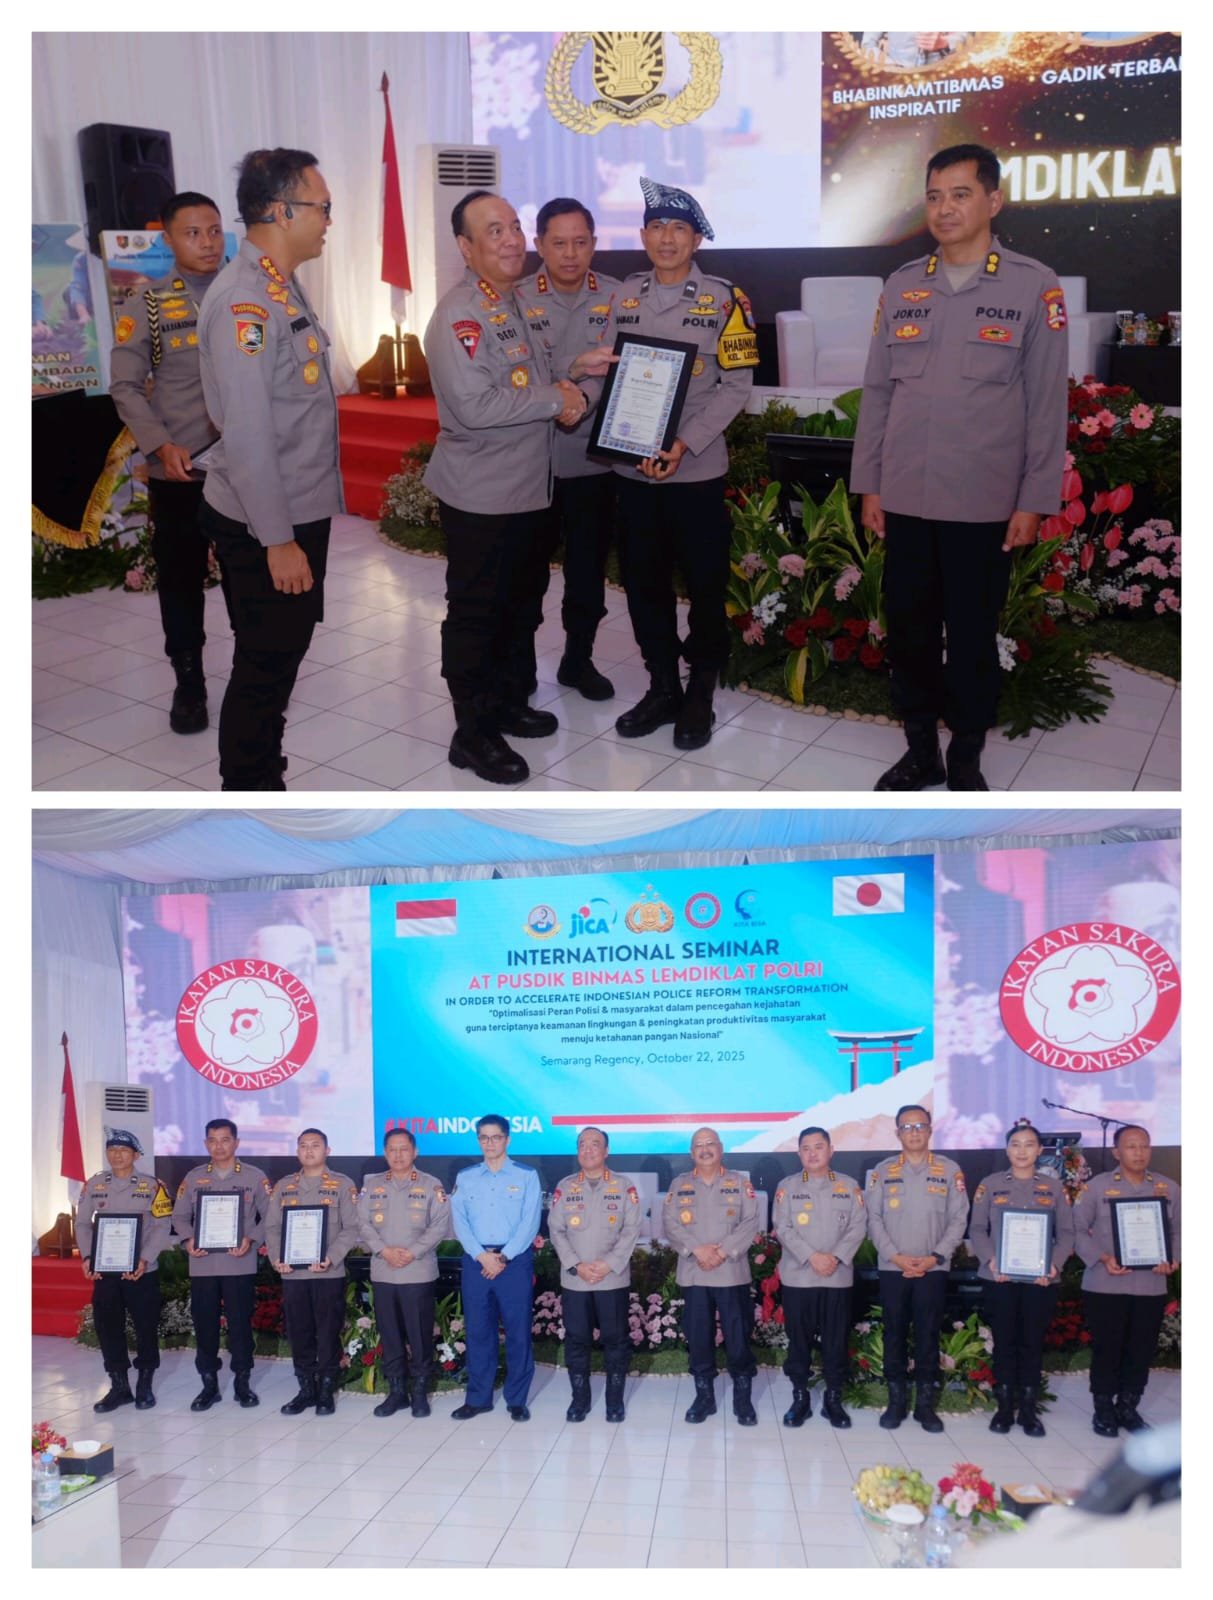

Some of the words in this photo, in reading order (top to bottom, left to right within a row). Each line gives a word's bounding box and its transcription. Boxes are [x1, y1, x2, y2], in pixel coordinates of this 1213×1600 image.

[1041, 64, 1106, 85] GADIK
[832, 75, 1004, 104] BHABINKAMTIBMAS
[869, 98, 961, 120] INSPIRATIF
[999, 147, 1181, 202] MDIKLA
[682, 317, 719, 329] POLRI
[893, 308, 931, 320] JOKO.Y
[975, 306, 1021, 321] POLRI
[496, 327, 517, 342] DEDI
[32, 352, 72, 364] MAN
[32, 366, 97, 377] MBADA
[507, 943, 675, 966] INTERNATIONAL
[682, 939, 779, 960] SEMINAR
[1003, 926, 1080, 998] IKATAN
[1089, 923, 1177, 994] SAKURA
[468, 975, 492, 990] AT
[497, 972, 565, 989] PUSDIK
[572, 968, 645, 987] BINMAS
[652, 964, 758, 983] LEMDIKLAT
[764, 961, 823, 979] POLRI
[179, 962, 237, 1024] IKATAN
[244, 960, 315, 1023] SAKURA
[446, 997, 456, 1006] IN
[459, 996, 495, 1006] ORDER
[498, 995, 512, 1005] TO
[515, 993, 580, 1004] ACCELERATE
[583, 991, 650, 1001] INDONESIAN
[653, 989, 692, 999] POLICE
[696, 987, 741, 998] REFORM
[745, 983, 849, 996] TRANSFORMATION
[548, 1007, 574, 1016] Peran
[575, 1006, 600, 1015] Polisi
[601, 1006, 608, 1014] &
[610, 1004, 663, 1015] masyarakat
[666, 1003, 693, 1012] dalam
[696, 1001, 752, 1013] pencegahan
[754, 1000, 801, 1010] kejahatan
[465, 1025, 487, 1034] guna
[489, 1022, 539, 1033] terciptanya
[540, 1021, 586, 1030] keamanan
[587, 1019, 637, 1031] lingkungan
[639, 1019, 645, 1027] &
[648, 1016, 704, 1028] peningkatan
[706, 1014, 769, 1026] produktivitas
[771, 1013, 827, 1024] masyarakat
[561, 1035, 594, 1044] menuju
[595, 1033, 643, 1042] ketahanan
[644, 1033, 678, 1042] pangan
[540, 1055, 592, 1067] Semarang
[594, 1054, 644, 1066] Regency,
[647, 1053, 693, 1064] October
[696, 1052, 713, 1063] 22,
[717, 1051, 745, 1061] 2025
[1026, 1036, 1158, 1071] INDONESIA
[199, 1060, 301, 1089] INDONESIA
